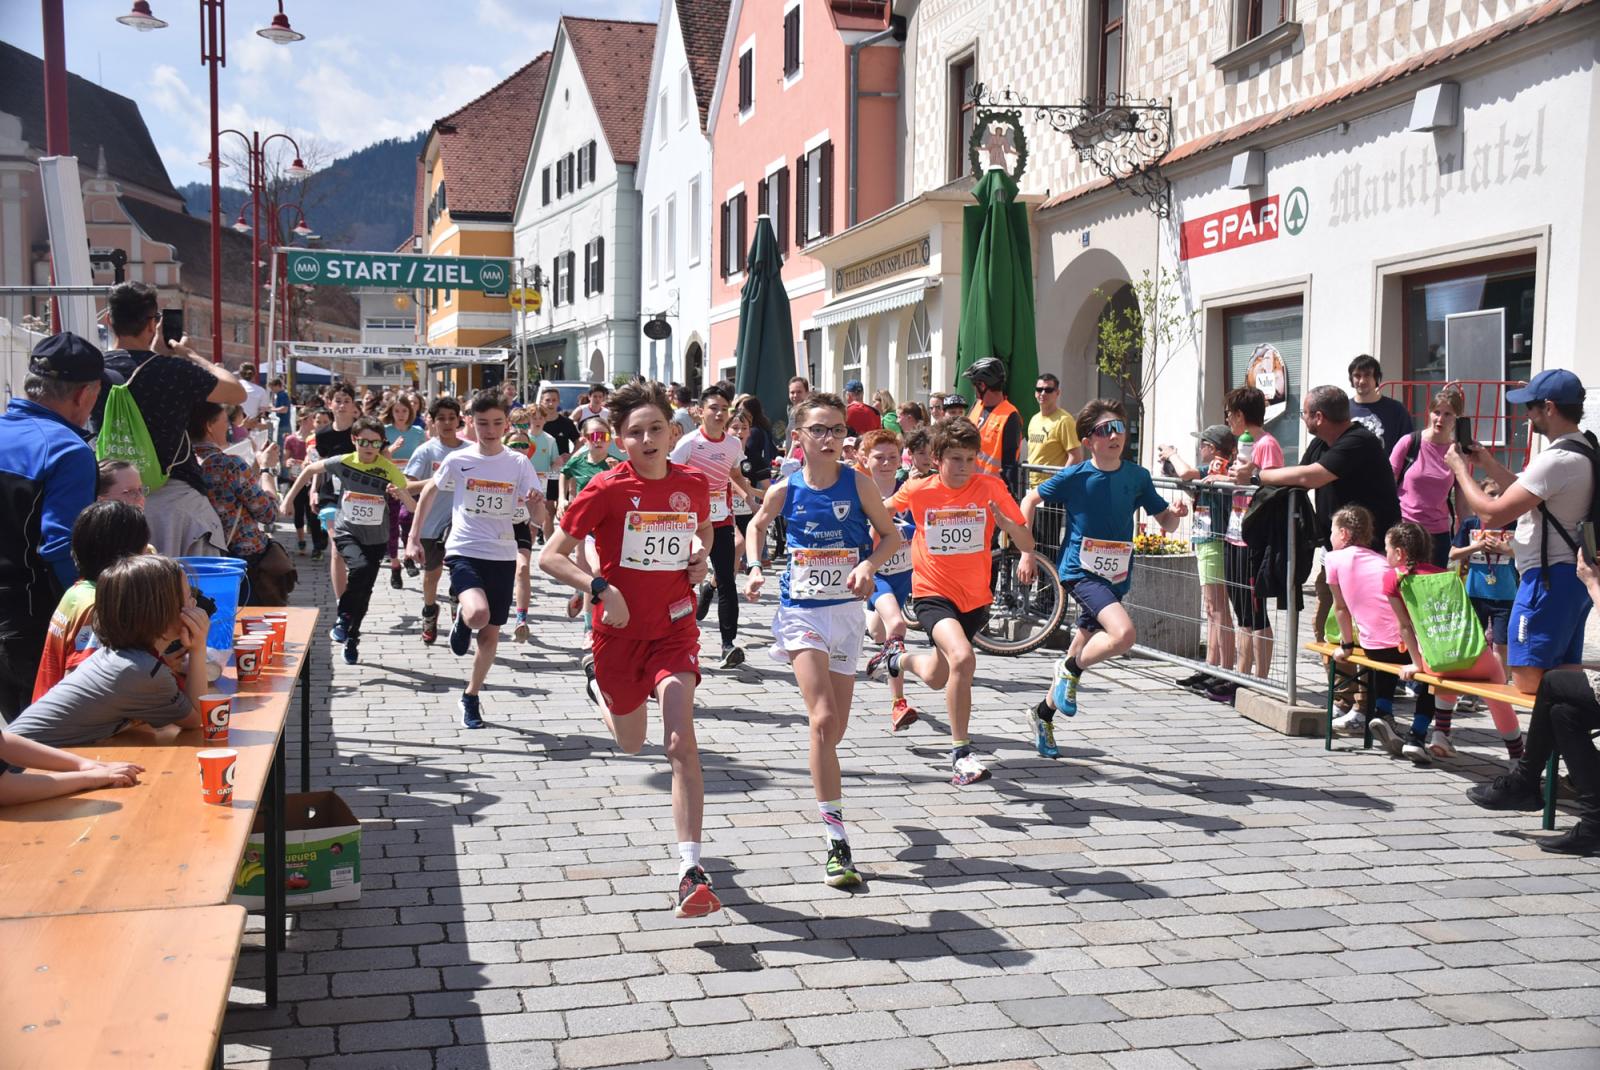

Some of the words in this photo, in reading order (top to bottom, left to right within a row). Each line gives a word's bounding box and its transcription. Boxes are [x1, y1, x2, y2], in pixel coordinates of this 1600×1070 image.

[1328, 104, 1548, 227] Marktplatzl
[1202, 202, 1278, 249] SPAR
[297, 264, 317, 272] MM
[326, 260, 401, 280] START
[407, 262, 417, 283] /
[423, 264, 474, 284] ZIEL
[483, 271, 501, 280] MM
[362, 346, 385, 354] ZIEL
[454, 348, 476, 356] ZIEL
[476, 495, 503, 509] 513
[733, 499, 745, 508] 34
[352, 505, 373, 517] 553
[513, 508, 525, 517] 29
[641, 521, 687, 533] Frohnleiten
[941, 528, 972, 544] 509
[644, 536, 680, 555] 516
[1093, 556, 1119, 572] 555
[808, 570, 842, 587] 502
[239, 653, 257, 671] G
[210, 704, 230, 727] G
[284, 851, 318, 862] Banan
